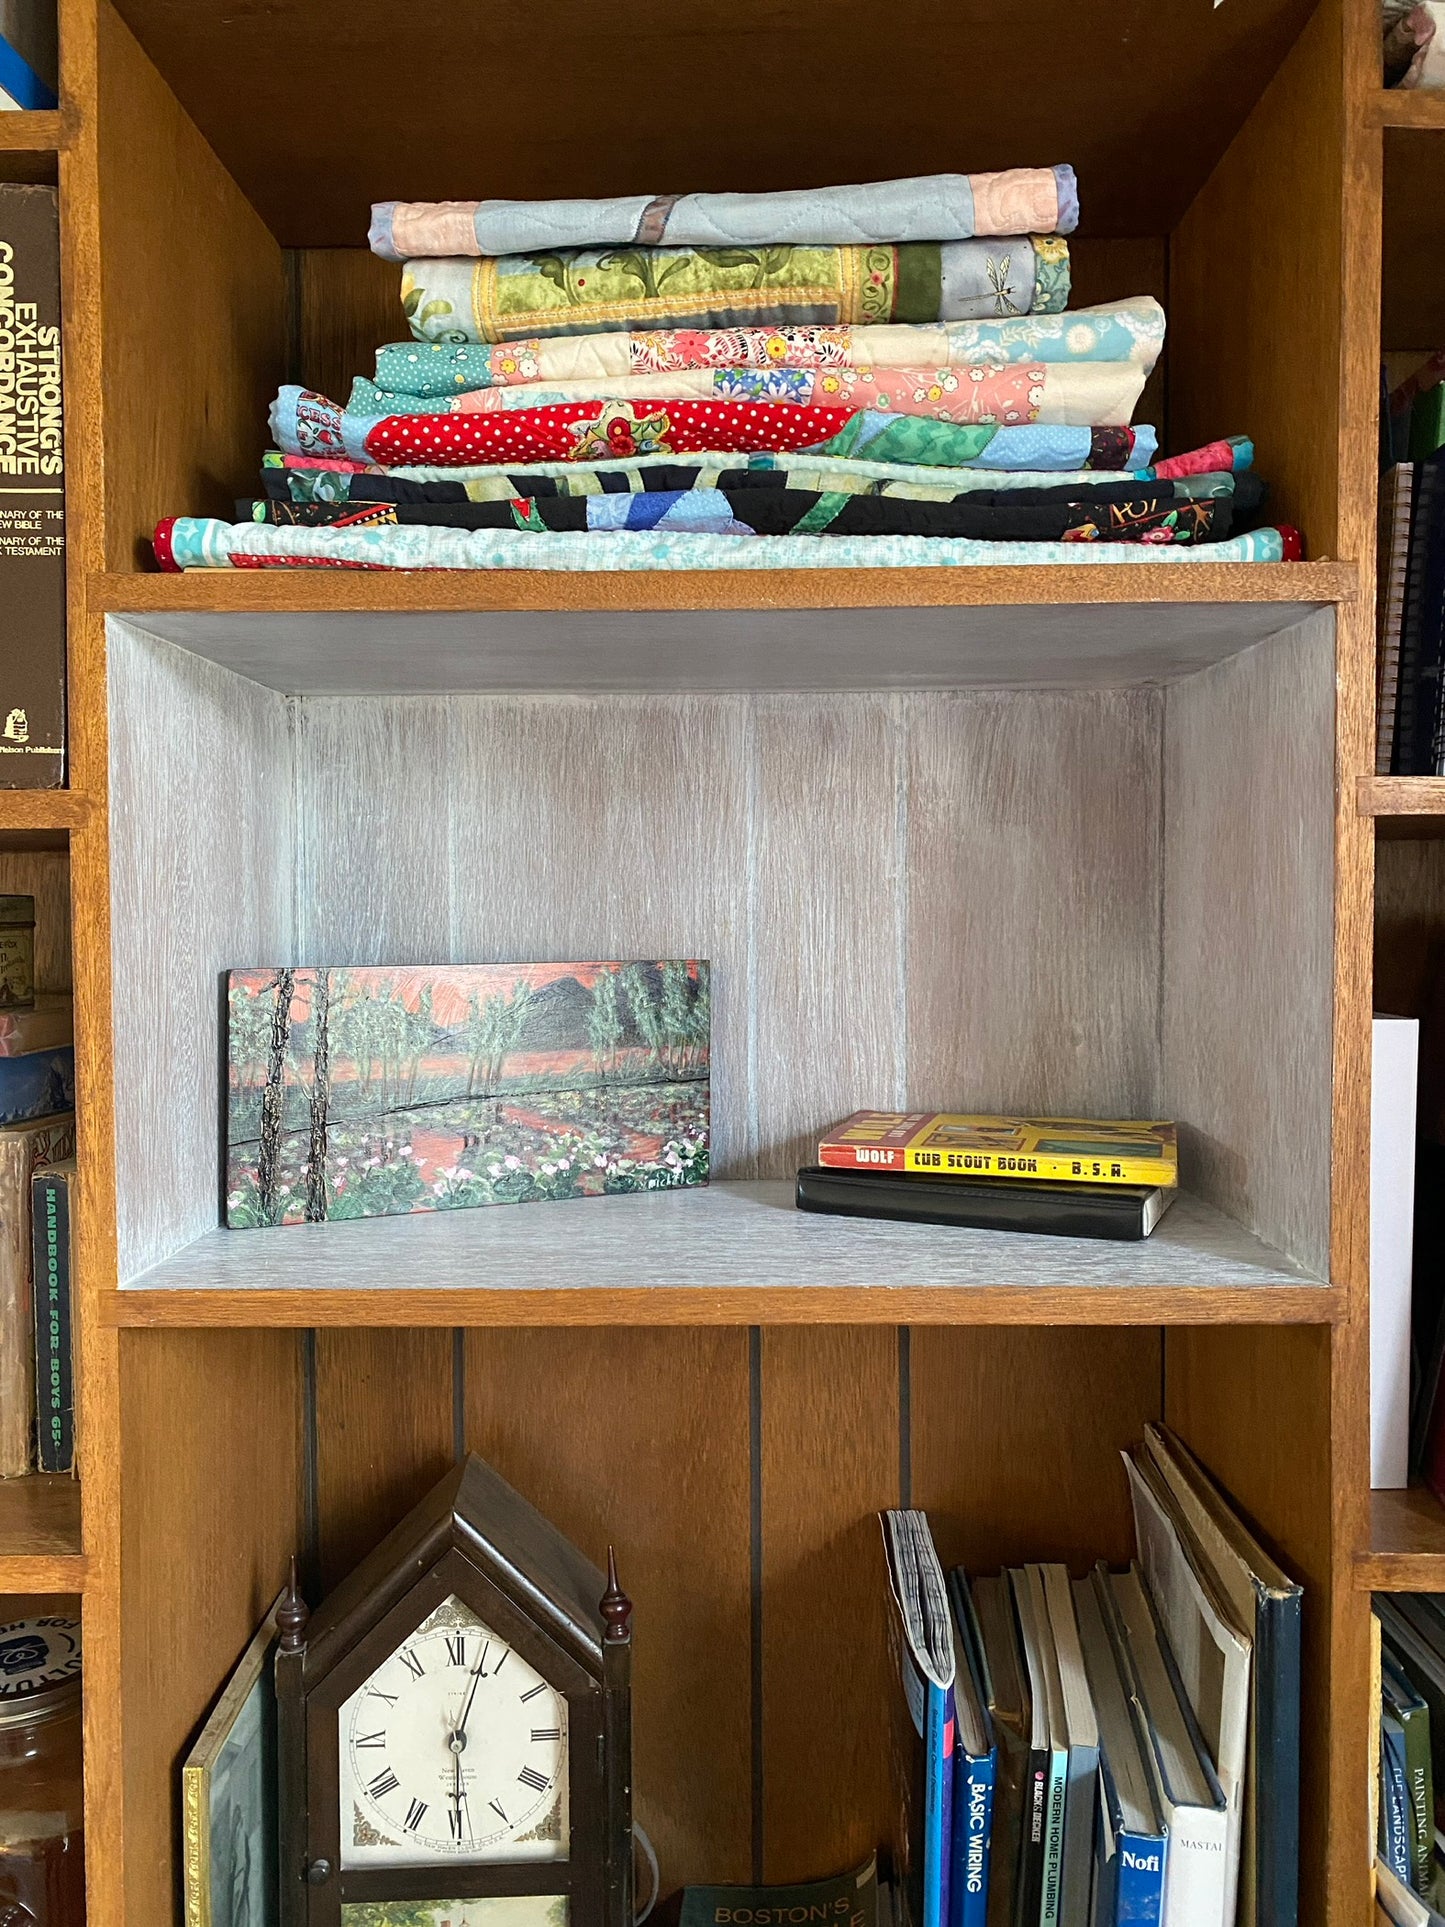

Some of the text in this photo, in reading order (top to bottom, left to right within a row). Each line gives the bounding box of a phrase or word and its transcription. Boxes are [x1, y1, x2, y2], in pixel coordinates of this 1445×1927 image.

[15, 302, 39, 475] EXHAUSTIVE
[38, 326, 64, 475] STRONG'S
[14, 520, 42, 530] BIBLE
[28, 510, 42, 519] OF
[46, 510, 64, 520] THE
[5, 546, 62, 556] TESTAMENT
[28, 536, 42, 546] OF
[45, 536, 64, 546] THE
[856, 1149, 895, 1164] WOLF
[914, 1152, 940, 1168] CUB
[947, 1154, 992, 1170] SCOUT
[998, 1157, 1038, 1172] BOOK
[46, 1188, 58, 1301] HANDBOOK
[50, 1310, 59, 1350] FOR
[50, 1358, 60, 1408] BOYS
[36, 1619, 80, 1630] FOR
[445, 1637, 466, 1666] XII
[398, 1649, 426, 1682] XI
[367, 1685, 399, 1708] X
[520, 1682, 548, 1703] II
[356, 1730, 386, 1749] IX
[531, 1728, 560, 1742] III
[366, 1766, 401, 1800] VIII
[404, 1797, 430, 1831] VII
[488, 1797, 510, 1824] V
[1414, 1768, 1428, 1839] PAINTING
[966, 1784, 986, 1893] BASIC WIRING
[1045, 1776, 1063, 1919] MODERN HOME PLUMBING
[1180, 1839, 1222, 1852] MASTAI
[1122, 1850, 1160, 1872] Nofi
[714, 1897, 850, 1925] BOSTON'S
